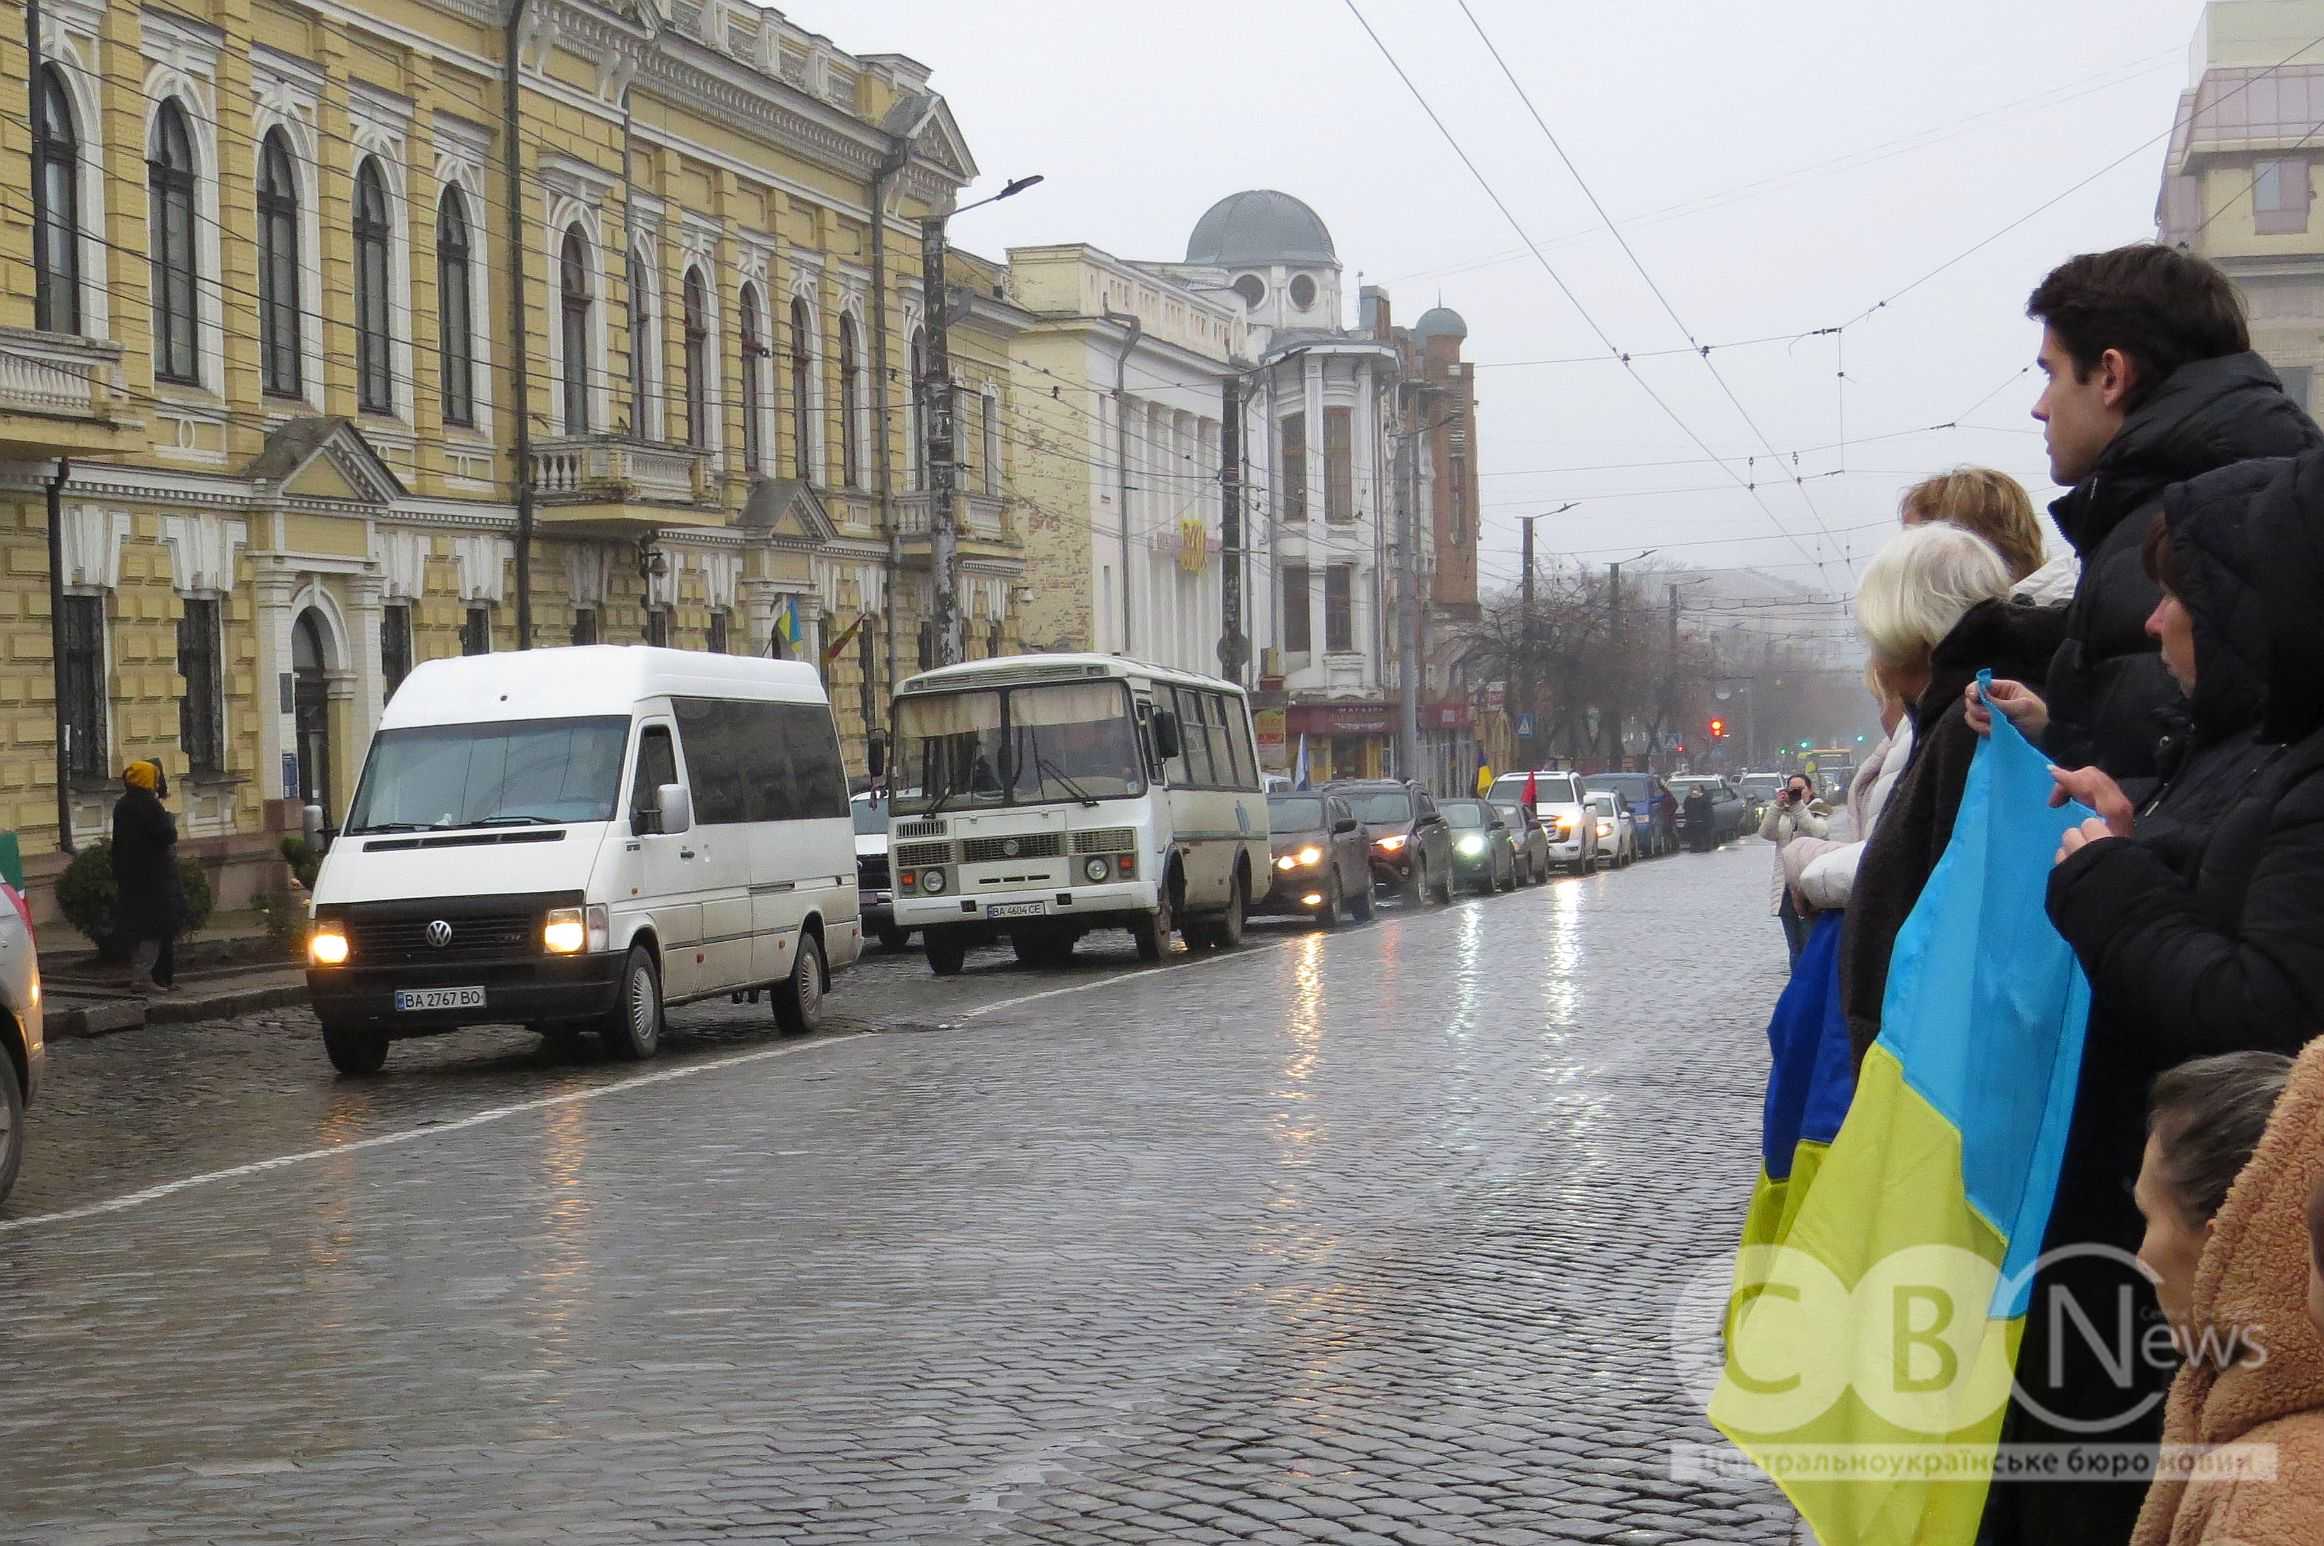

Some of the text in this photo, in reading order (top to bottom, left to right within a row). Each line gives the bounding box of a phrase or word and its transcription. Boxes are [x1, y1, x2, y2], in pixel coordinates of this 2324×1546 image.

[405, 990, 480, 1008] BA 2767 BO
